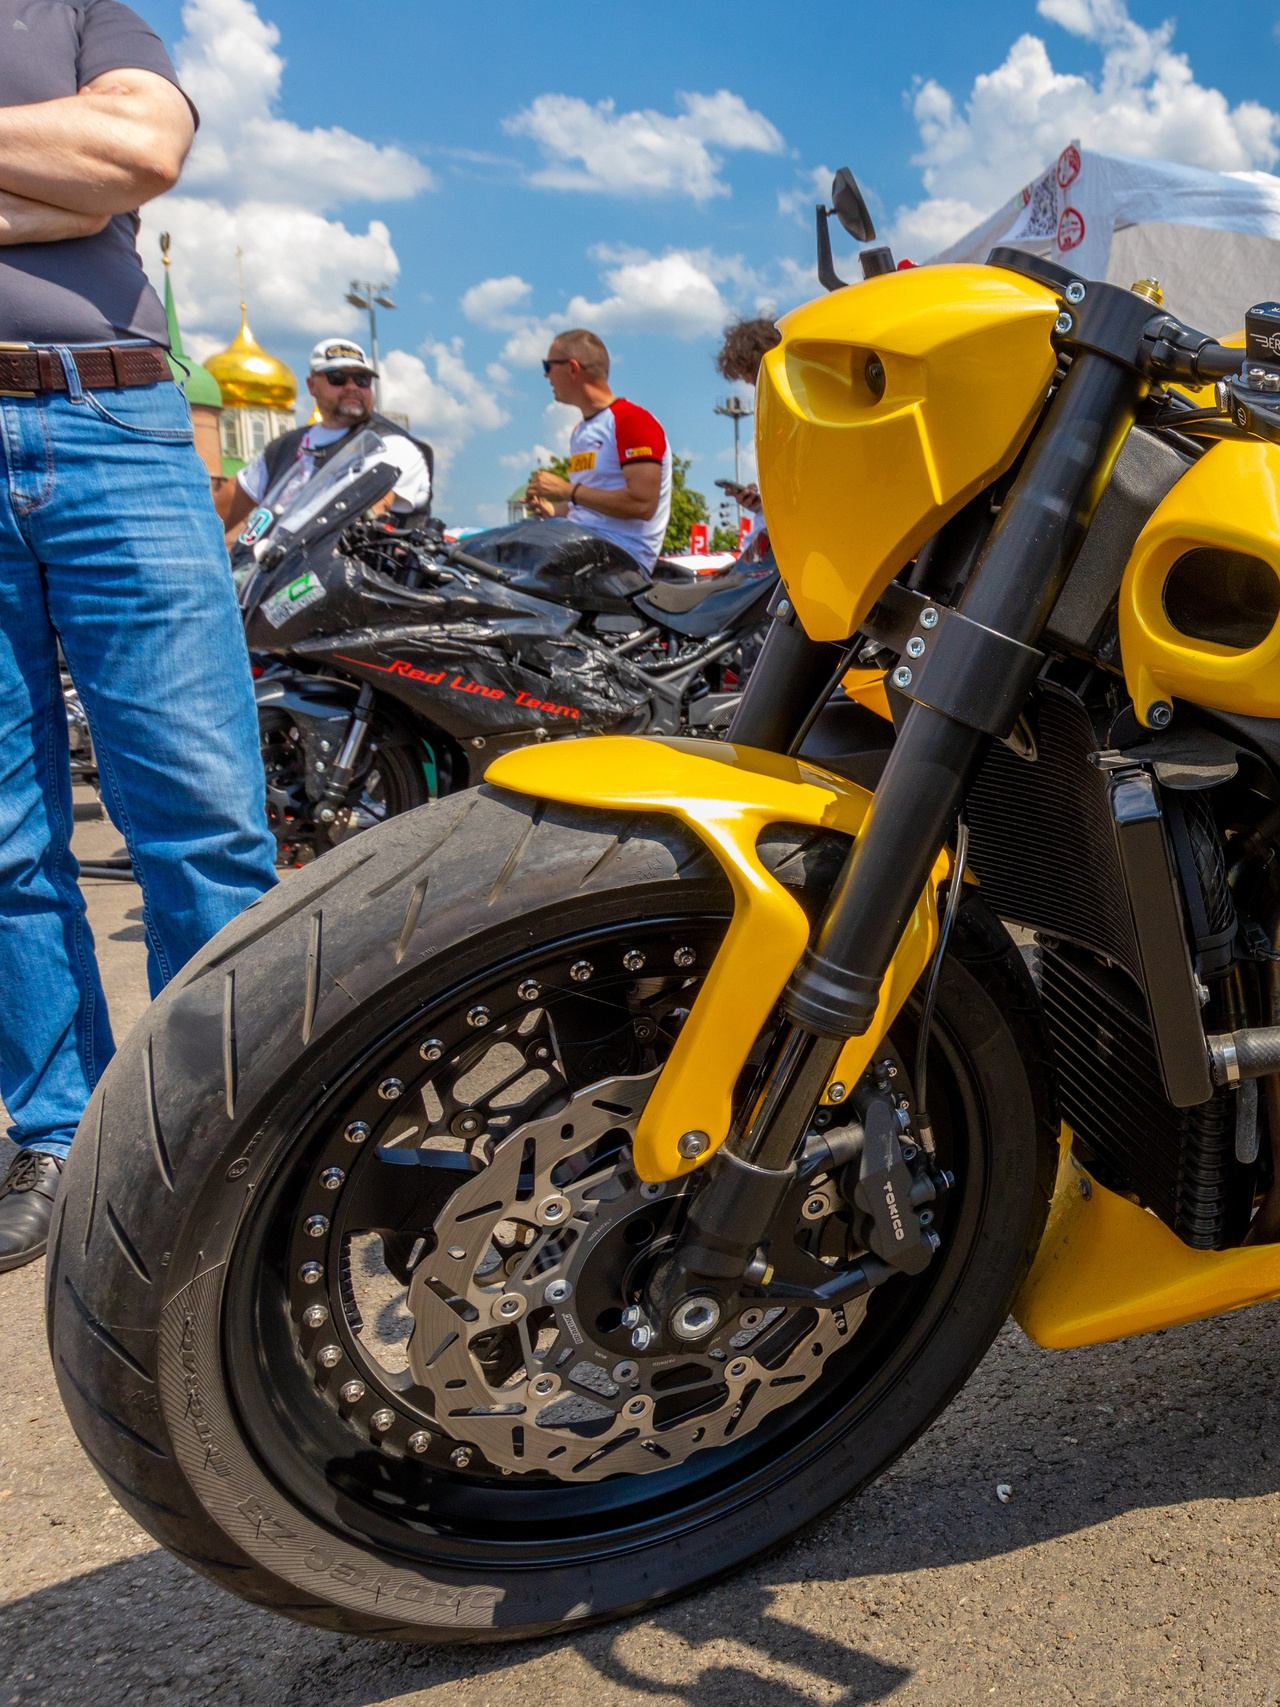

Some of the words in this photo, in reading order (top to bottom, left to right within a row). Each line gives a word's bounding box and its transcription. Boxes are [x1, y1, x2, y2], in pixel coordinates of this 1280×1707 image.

[387, 660, 448, 685] Red
[449, 676, 506, 700] Line
[514, 691, 583, 719] Team
[883, 1180, 905, 1241] TOKICO
[303, 1544, 541, 1609] OADTEC
